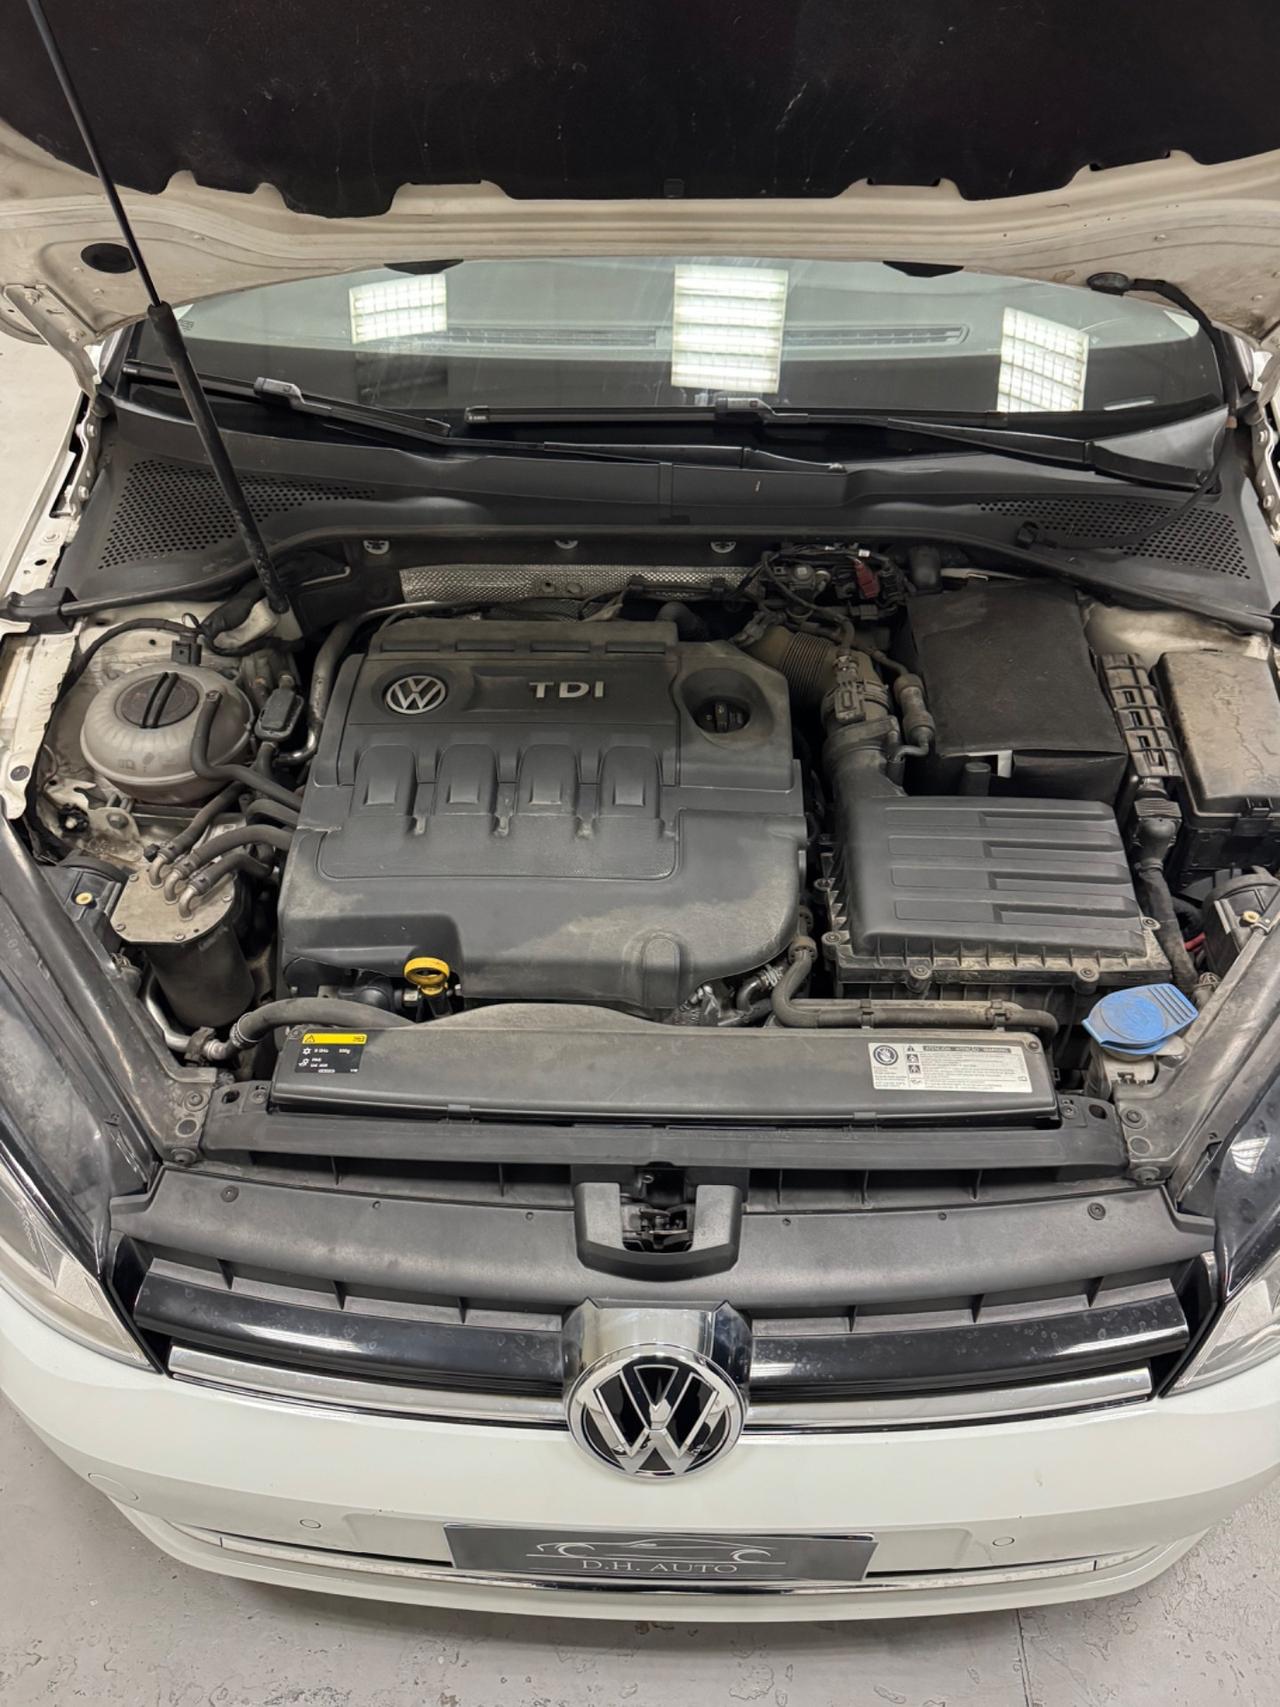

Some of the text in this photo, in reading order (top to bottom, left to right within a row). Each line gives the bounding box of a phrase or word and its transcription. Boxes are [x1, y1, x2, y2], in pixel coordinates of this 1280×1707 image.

[387, 676, 445, 713] VW
[529, 681, 604, 698] TDI
[572, 1351, 740, 1477] VW
[581, 1559, 738, 1573] D.H. AUTO
